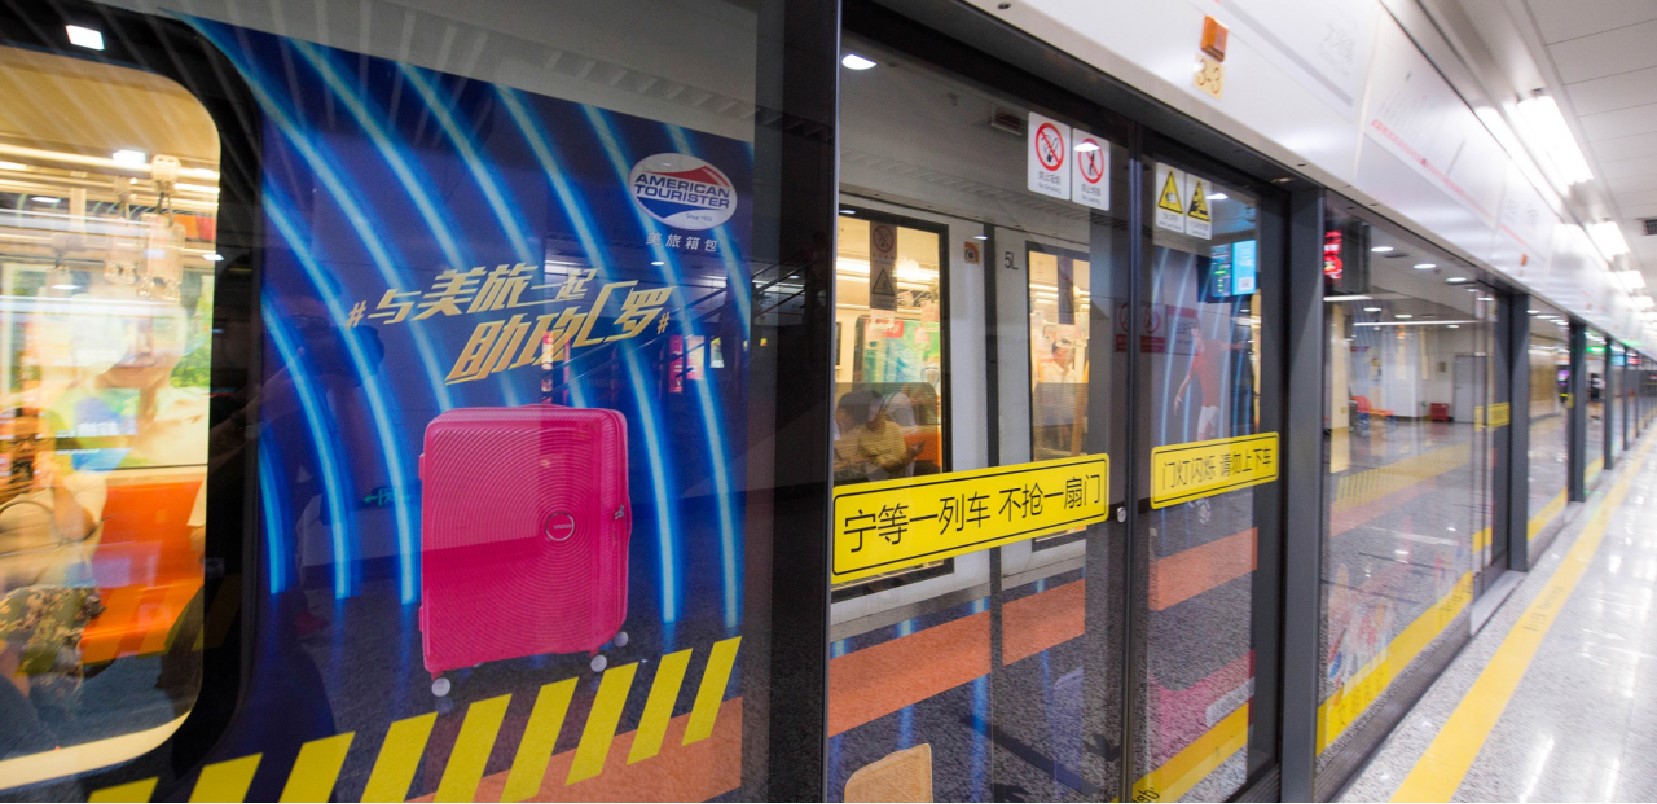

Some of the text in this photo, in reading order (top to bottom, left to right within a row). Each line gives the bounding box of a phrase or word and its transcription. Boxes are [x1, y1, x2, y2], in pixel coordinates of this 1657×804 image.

[1198, 57, 1220, 95] 3-3
[634, 184, 730, 209] TOURISTER
[635, 174, 730, 198] AMERICAN
[1004, 250, 1020, 270] 5L
[843, 474, 1101, 553] 宁等一列车 不抢一扇门
